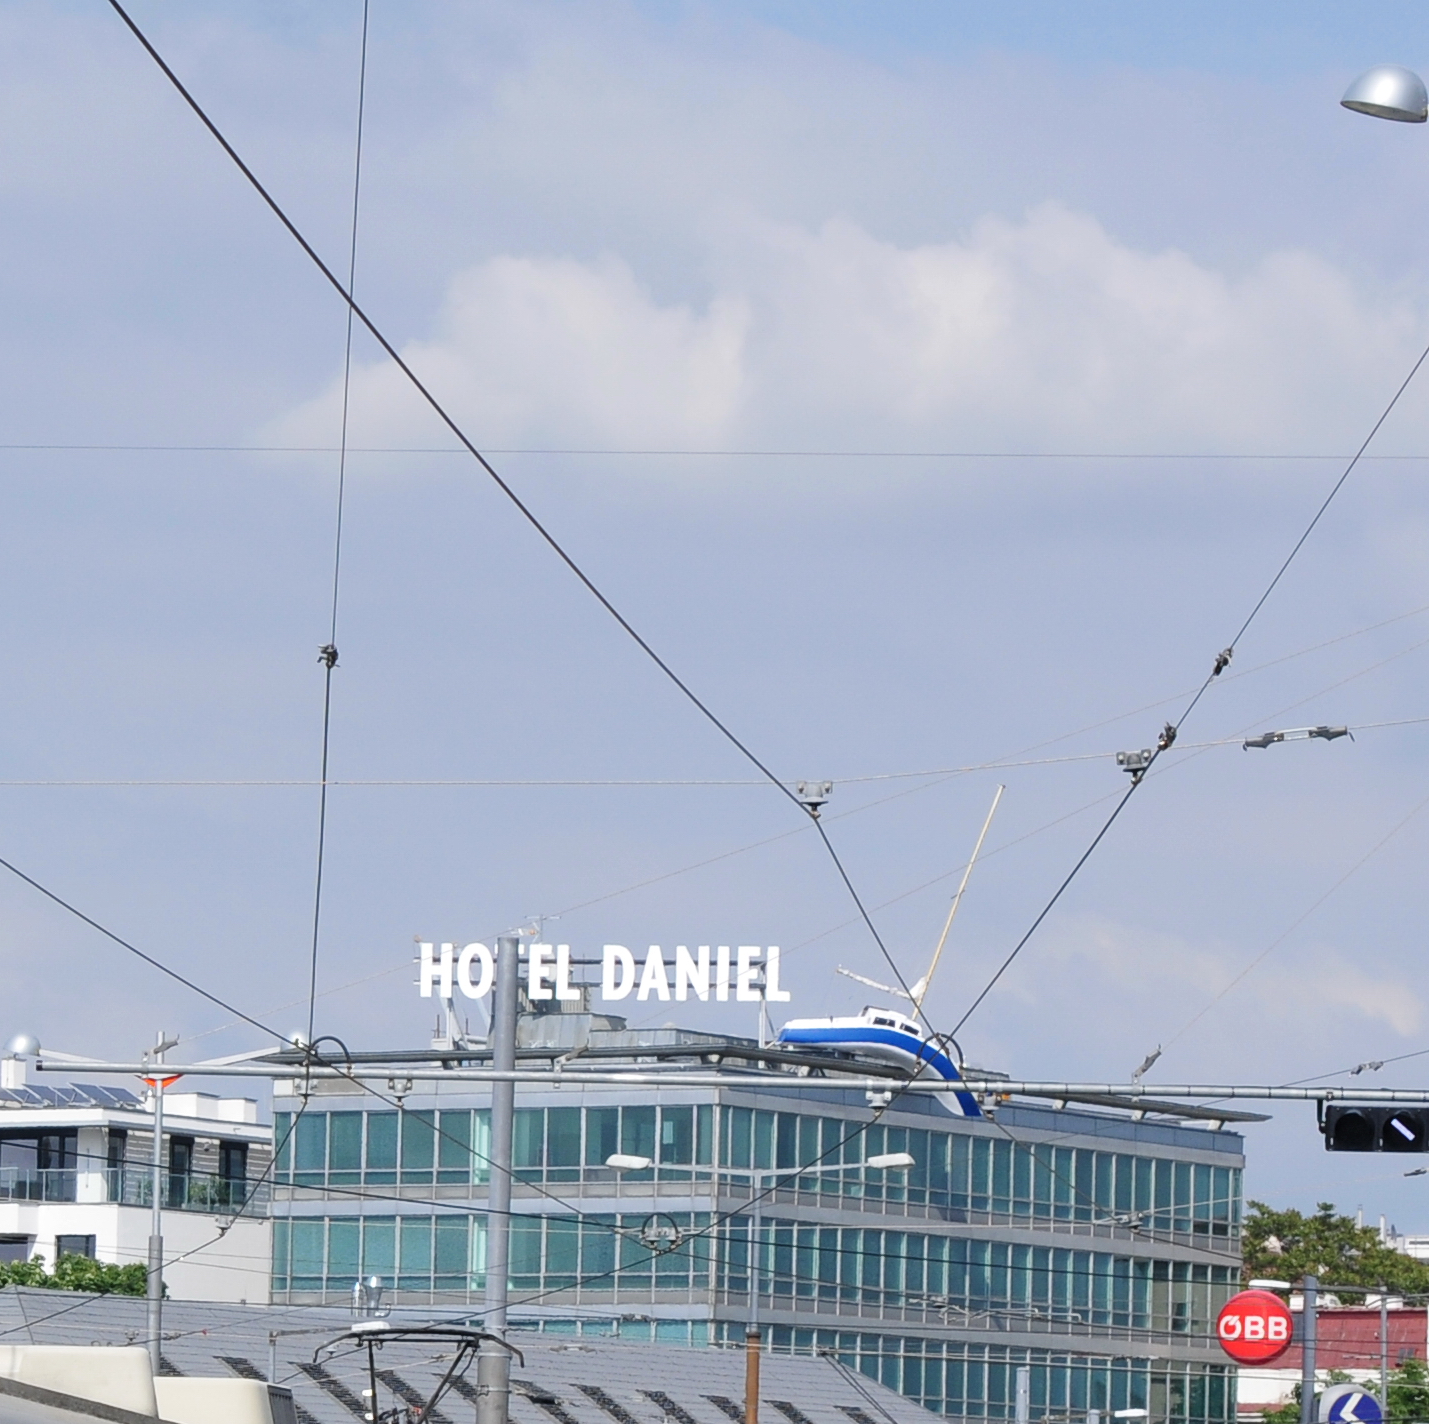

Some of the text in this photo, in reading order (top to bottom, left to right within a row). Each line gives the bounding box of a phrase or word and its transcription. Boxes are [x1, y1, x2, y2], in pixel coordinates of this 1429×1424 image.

[418, 942, 791, 1003] HOEL DANIEL
[1219, 1314, 1289, 1341] ÖBB
